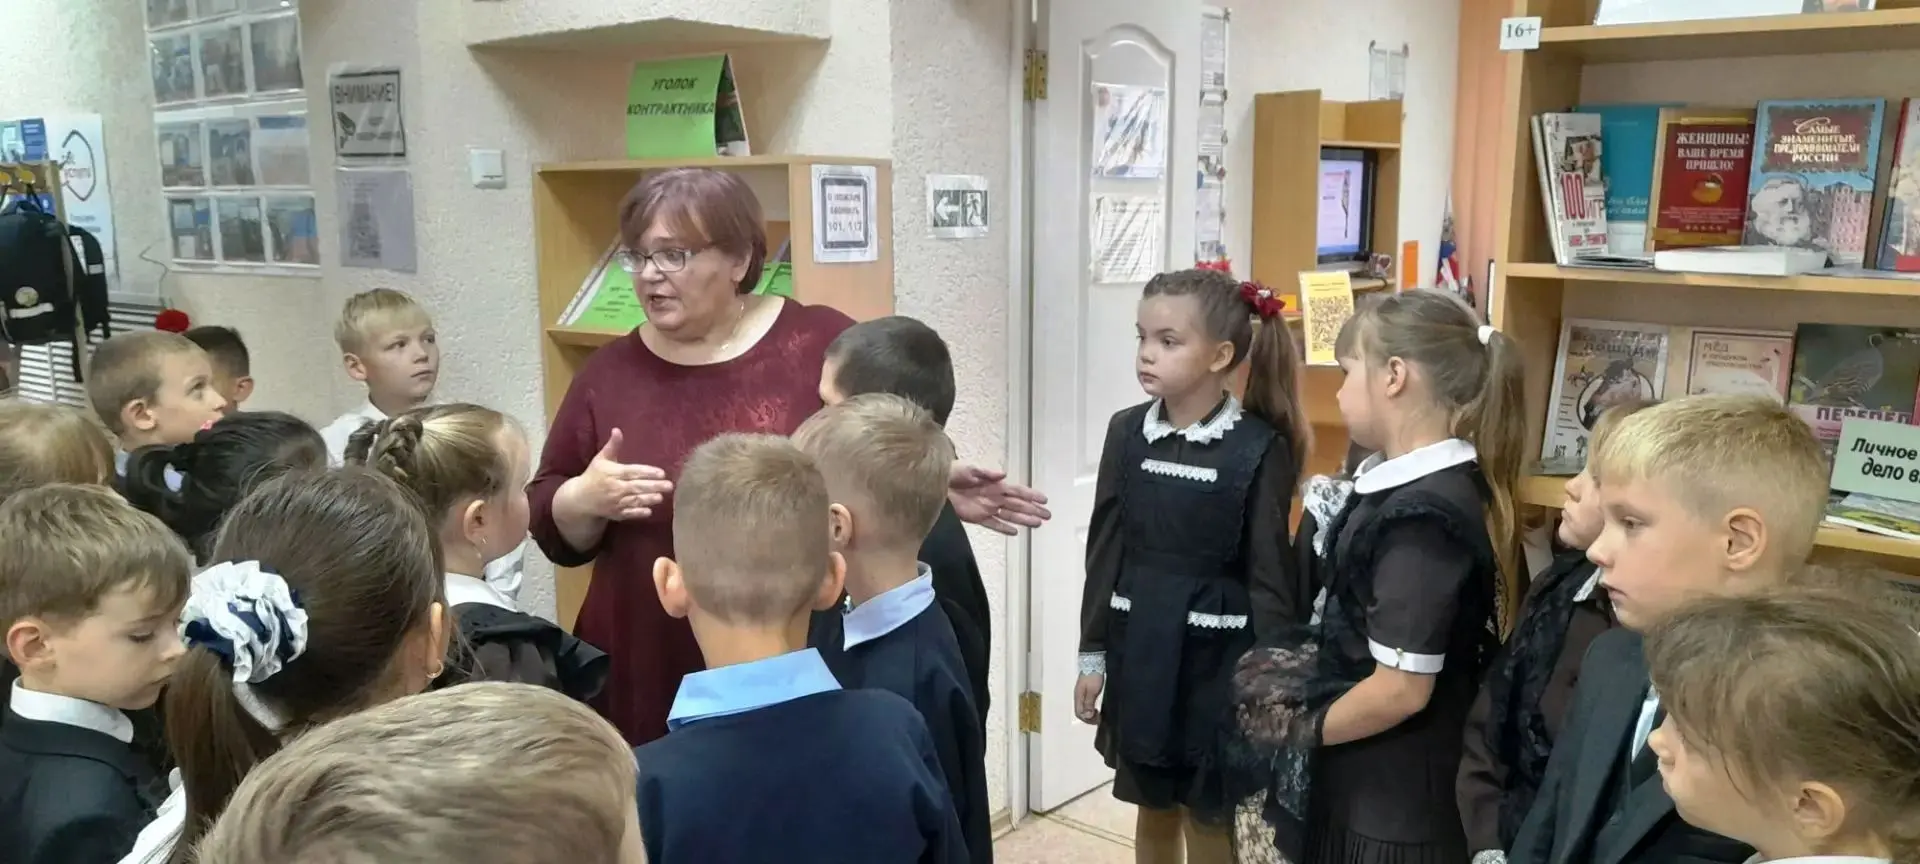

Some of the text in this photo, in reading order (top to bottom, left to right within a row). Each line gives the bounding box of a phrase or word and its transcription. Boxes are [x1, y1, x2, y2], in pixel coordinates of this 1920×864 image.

[1505, 23, 1536, 39] 16+
[651, 77, 698, 91] УГОЛОК
[334, 82, 397, 104] ВНИМАНИЕ!
[627, 102, 715, 116] КОНТРАКТНИКА
[1676, 132, 1750, 146] ЖЕНЩИНЫ!
[1780, 134, 1856, 144] ЗНАМЕНИТЫЕ
[1678, 148, 1744, 158] ВАШЕ ВРЕМЯ
[1773, 143, 1861, 154] ПРЕДПРИНИМАТЕЛИ
[1792, 153, 1840, 162] РОССИИ
[1686, 160, 1734, 170] ПРИШЛО!
[1560, 173, 1586, 220] 100
[1850, 437, 1918, 460] Личное
[1861, 457, 1920, 484] дело в
